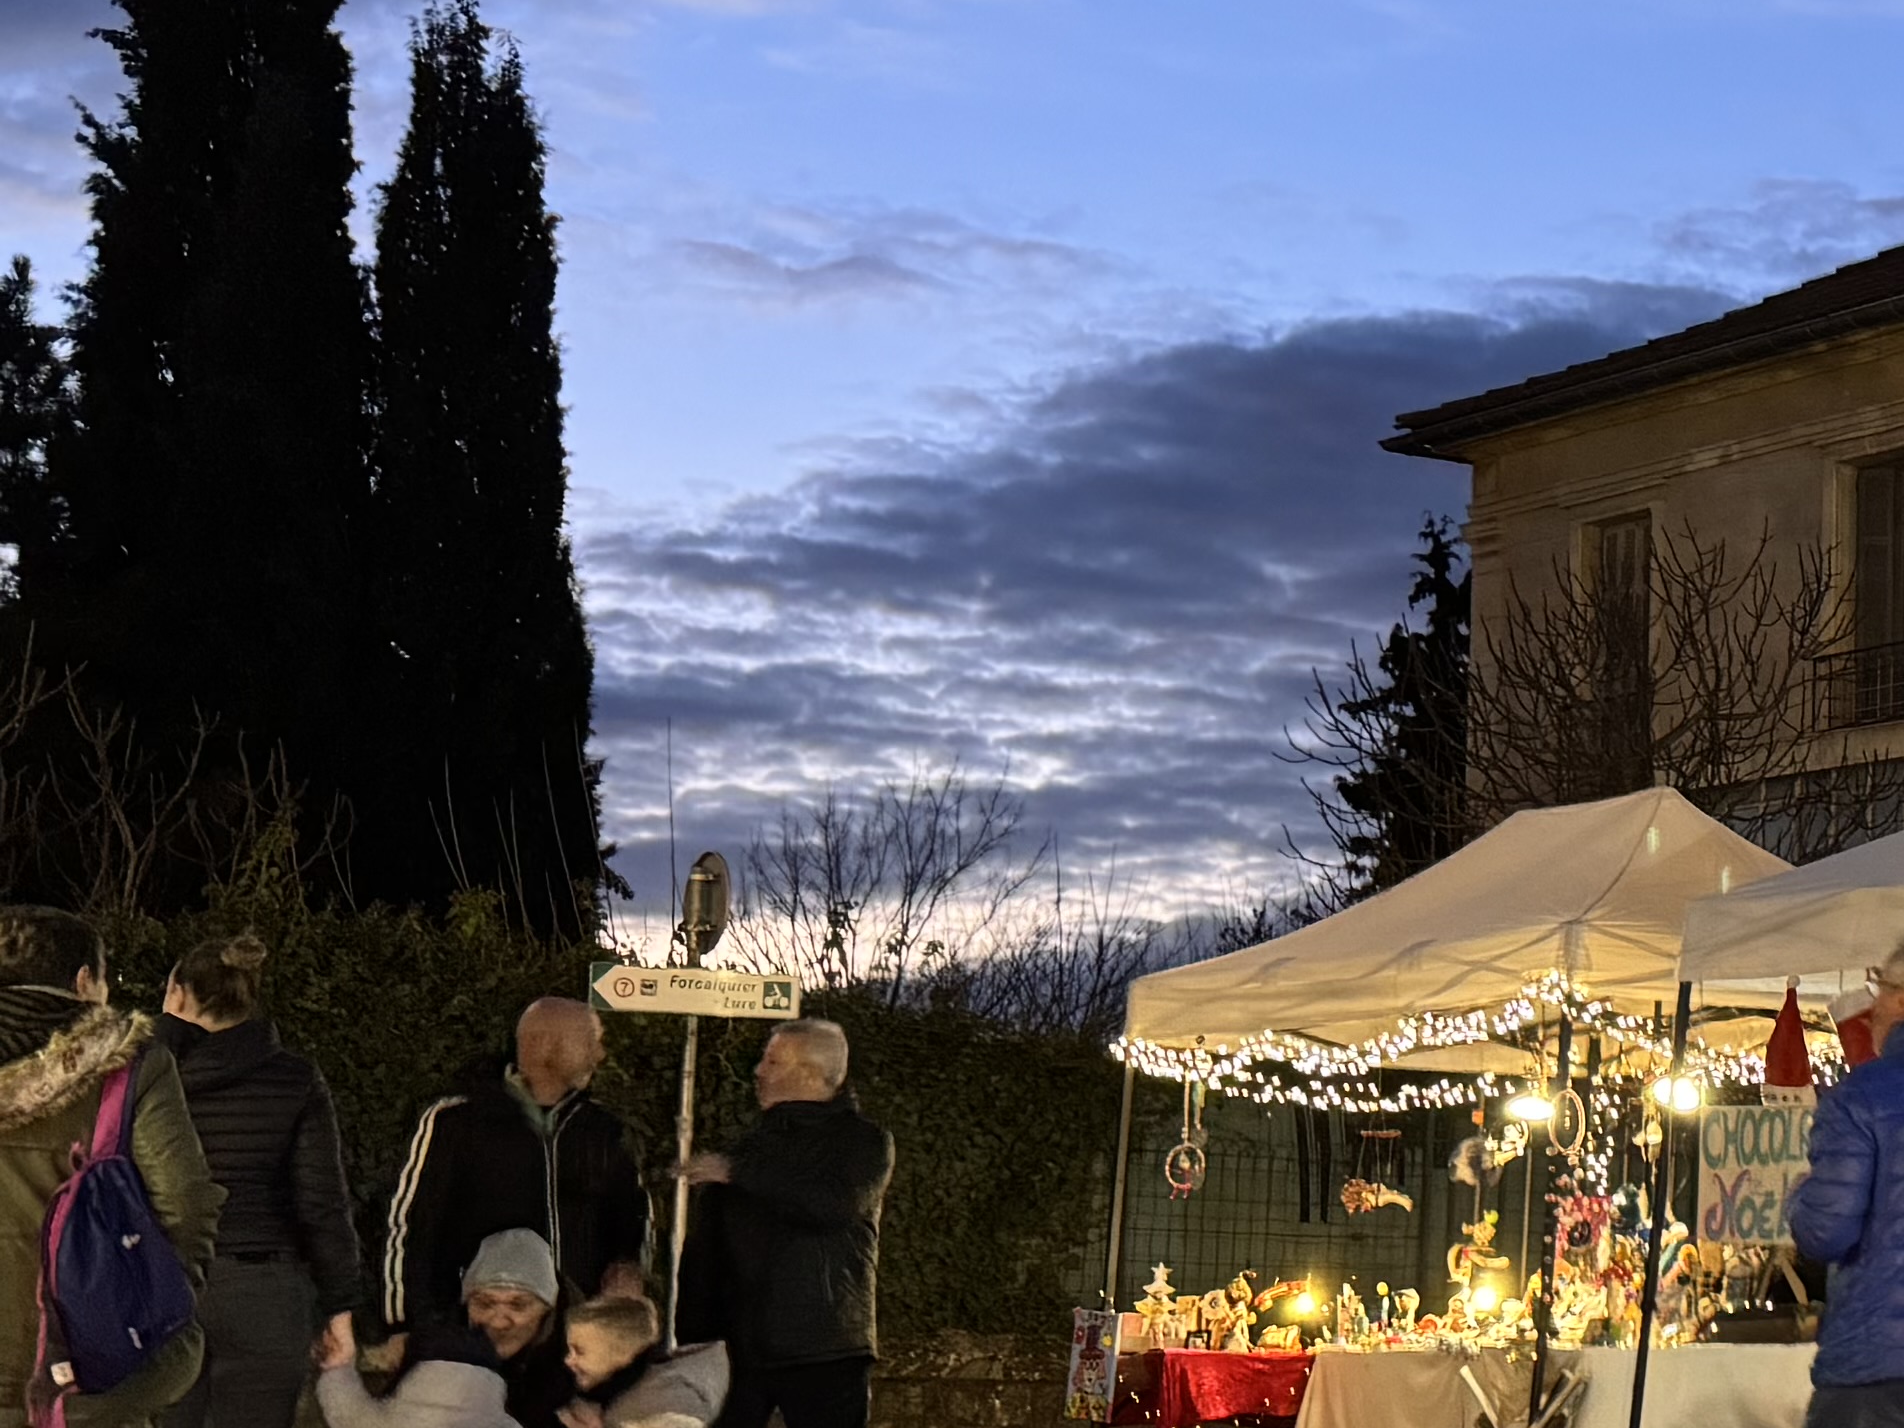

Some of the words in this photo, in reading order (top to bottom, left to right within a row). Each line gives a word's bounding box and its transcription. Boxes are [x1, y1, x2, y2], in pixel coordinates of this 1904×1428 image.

[620, 981, 628, 996] 7
[670, 975, 757, 993] Forcalquier
[723, 997, 756, 1010] Lure
